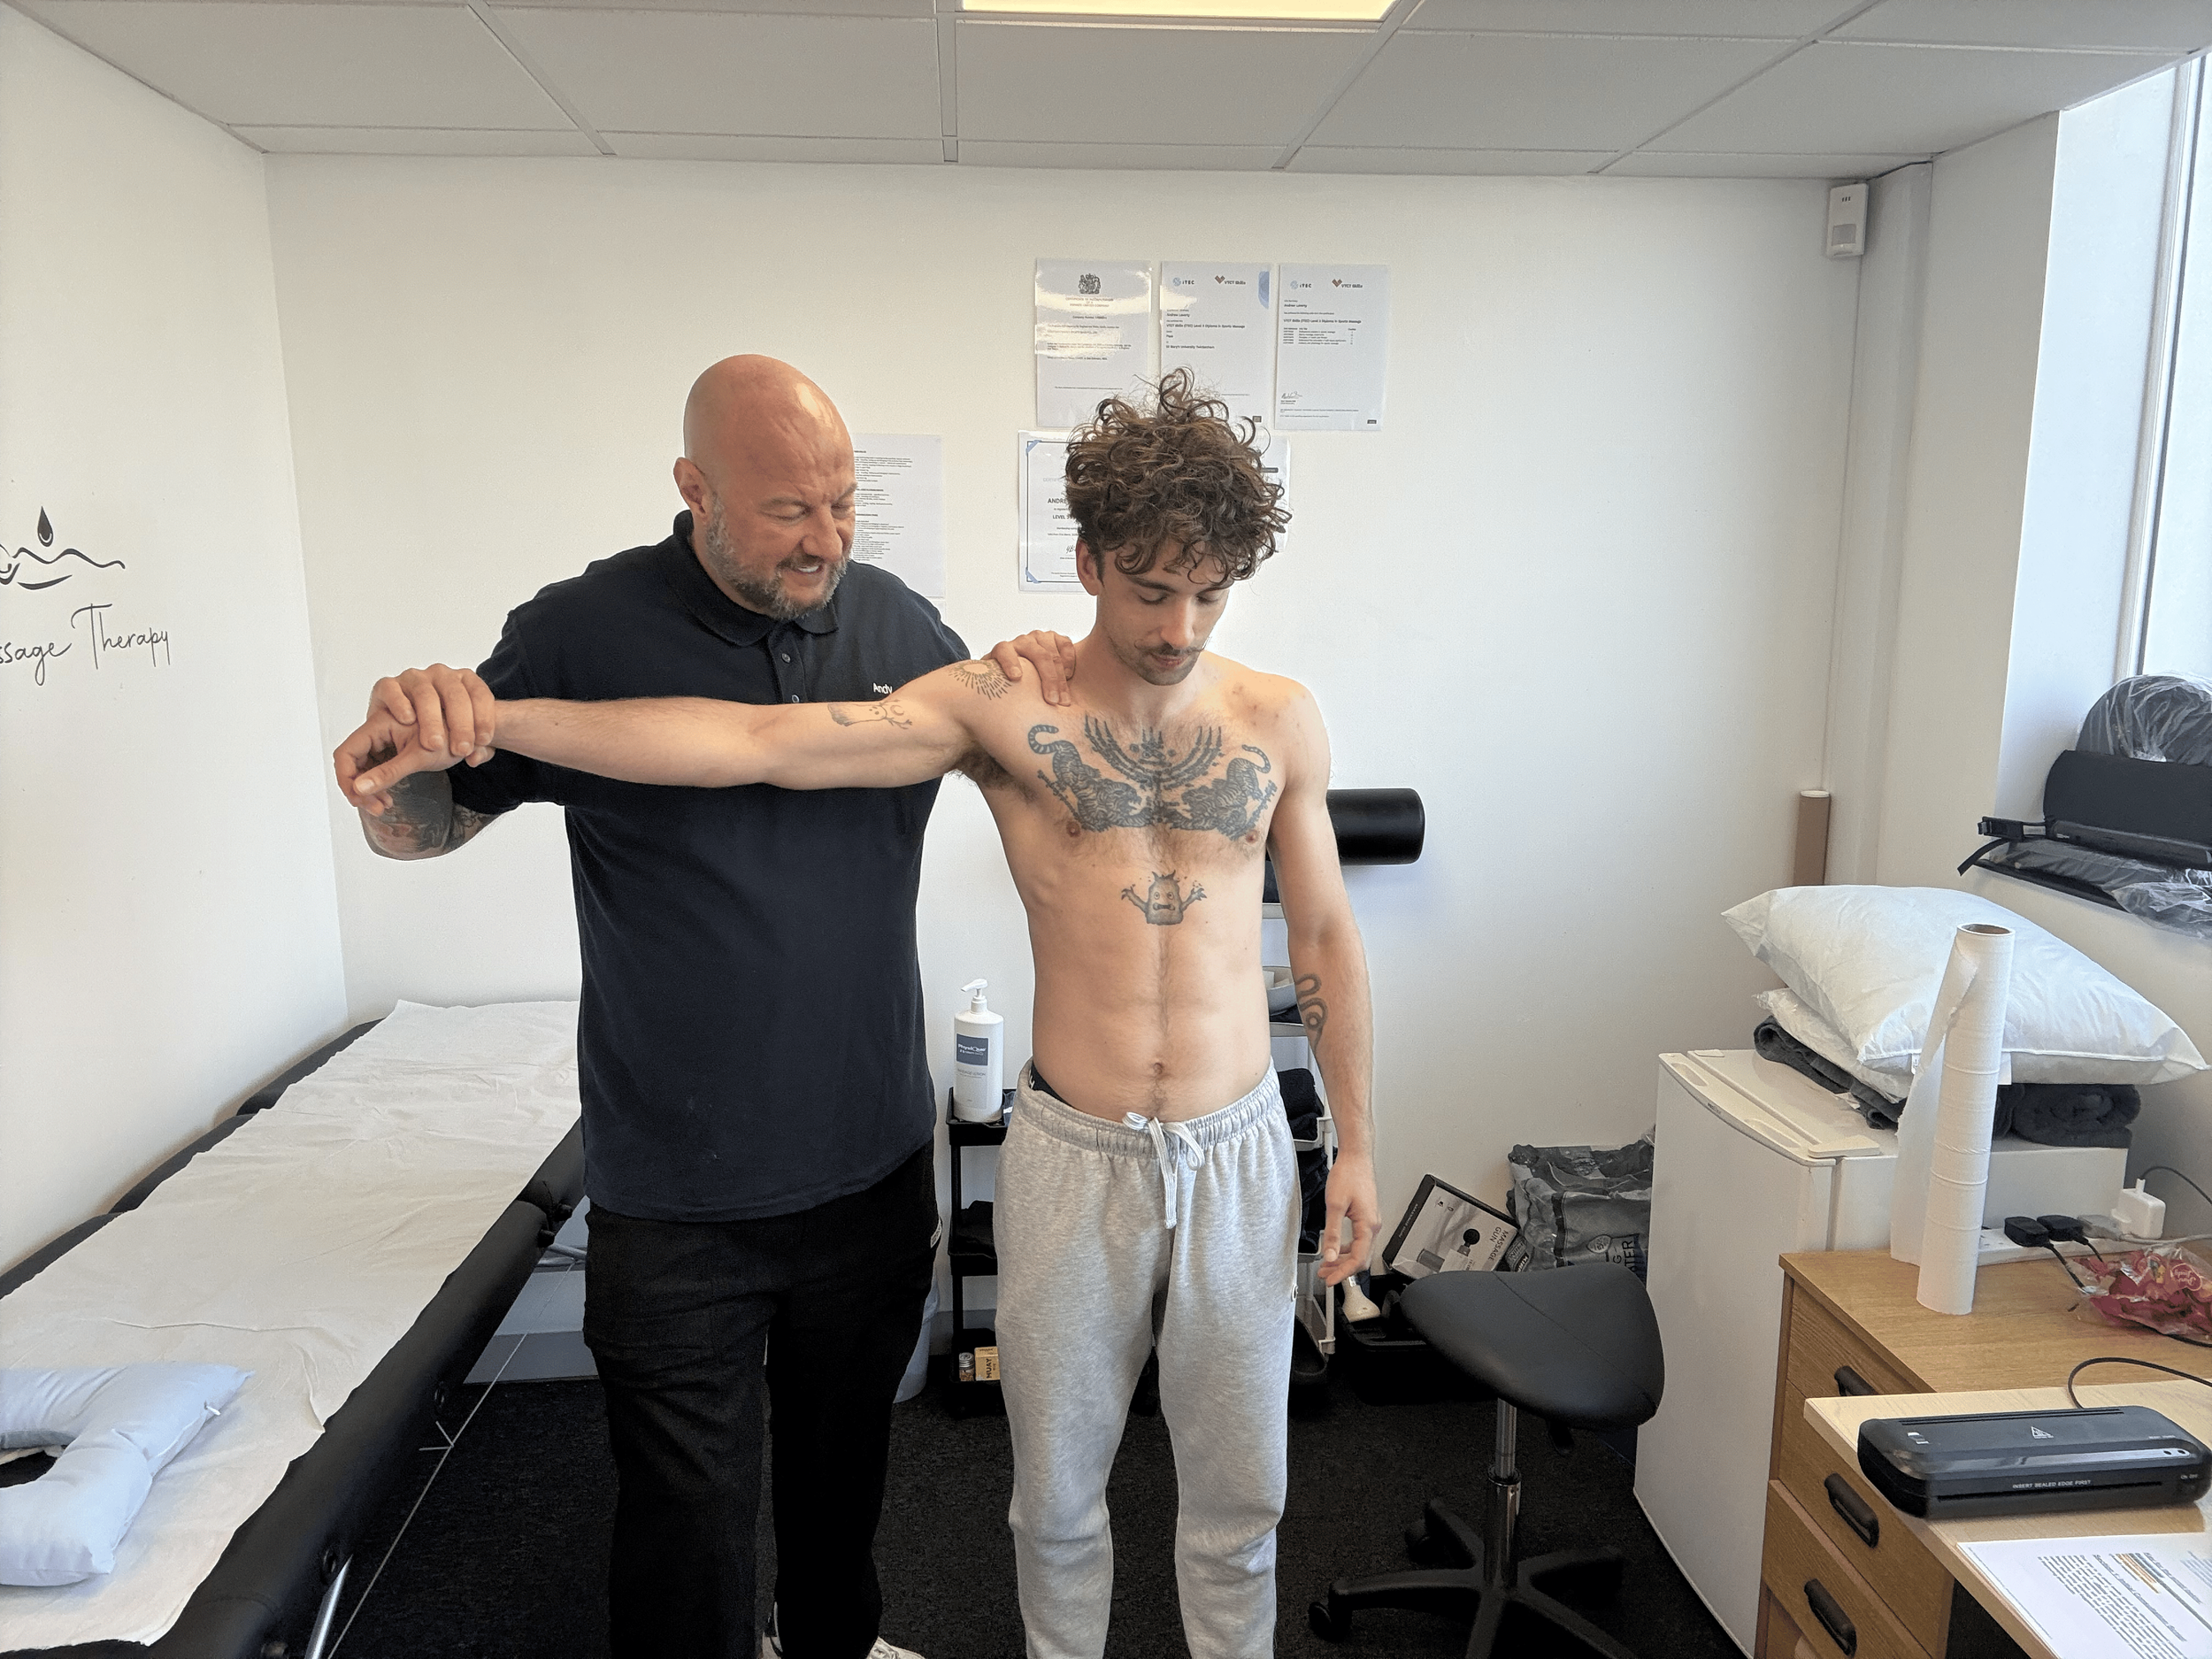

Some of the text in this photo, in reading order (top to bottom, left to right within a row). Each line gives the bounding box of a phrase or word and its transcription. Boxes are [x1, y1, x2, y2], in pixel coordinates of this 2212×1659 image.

[71, 603, 171, 670] Therapy
[1487, 1230, 1509, 1261] MASSAGE
[1489, 1226, 1502, 1242] GUN
